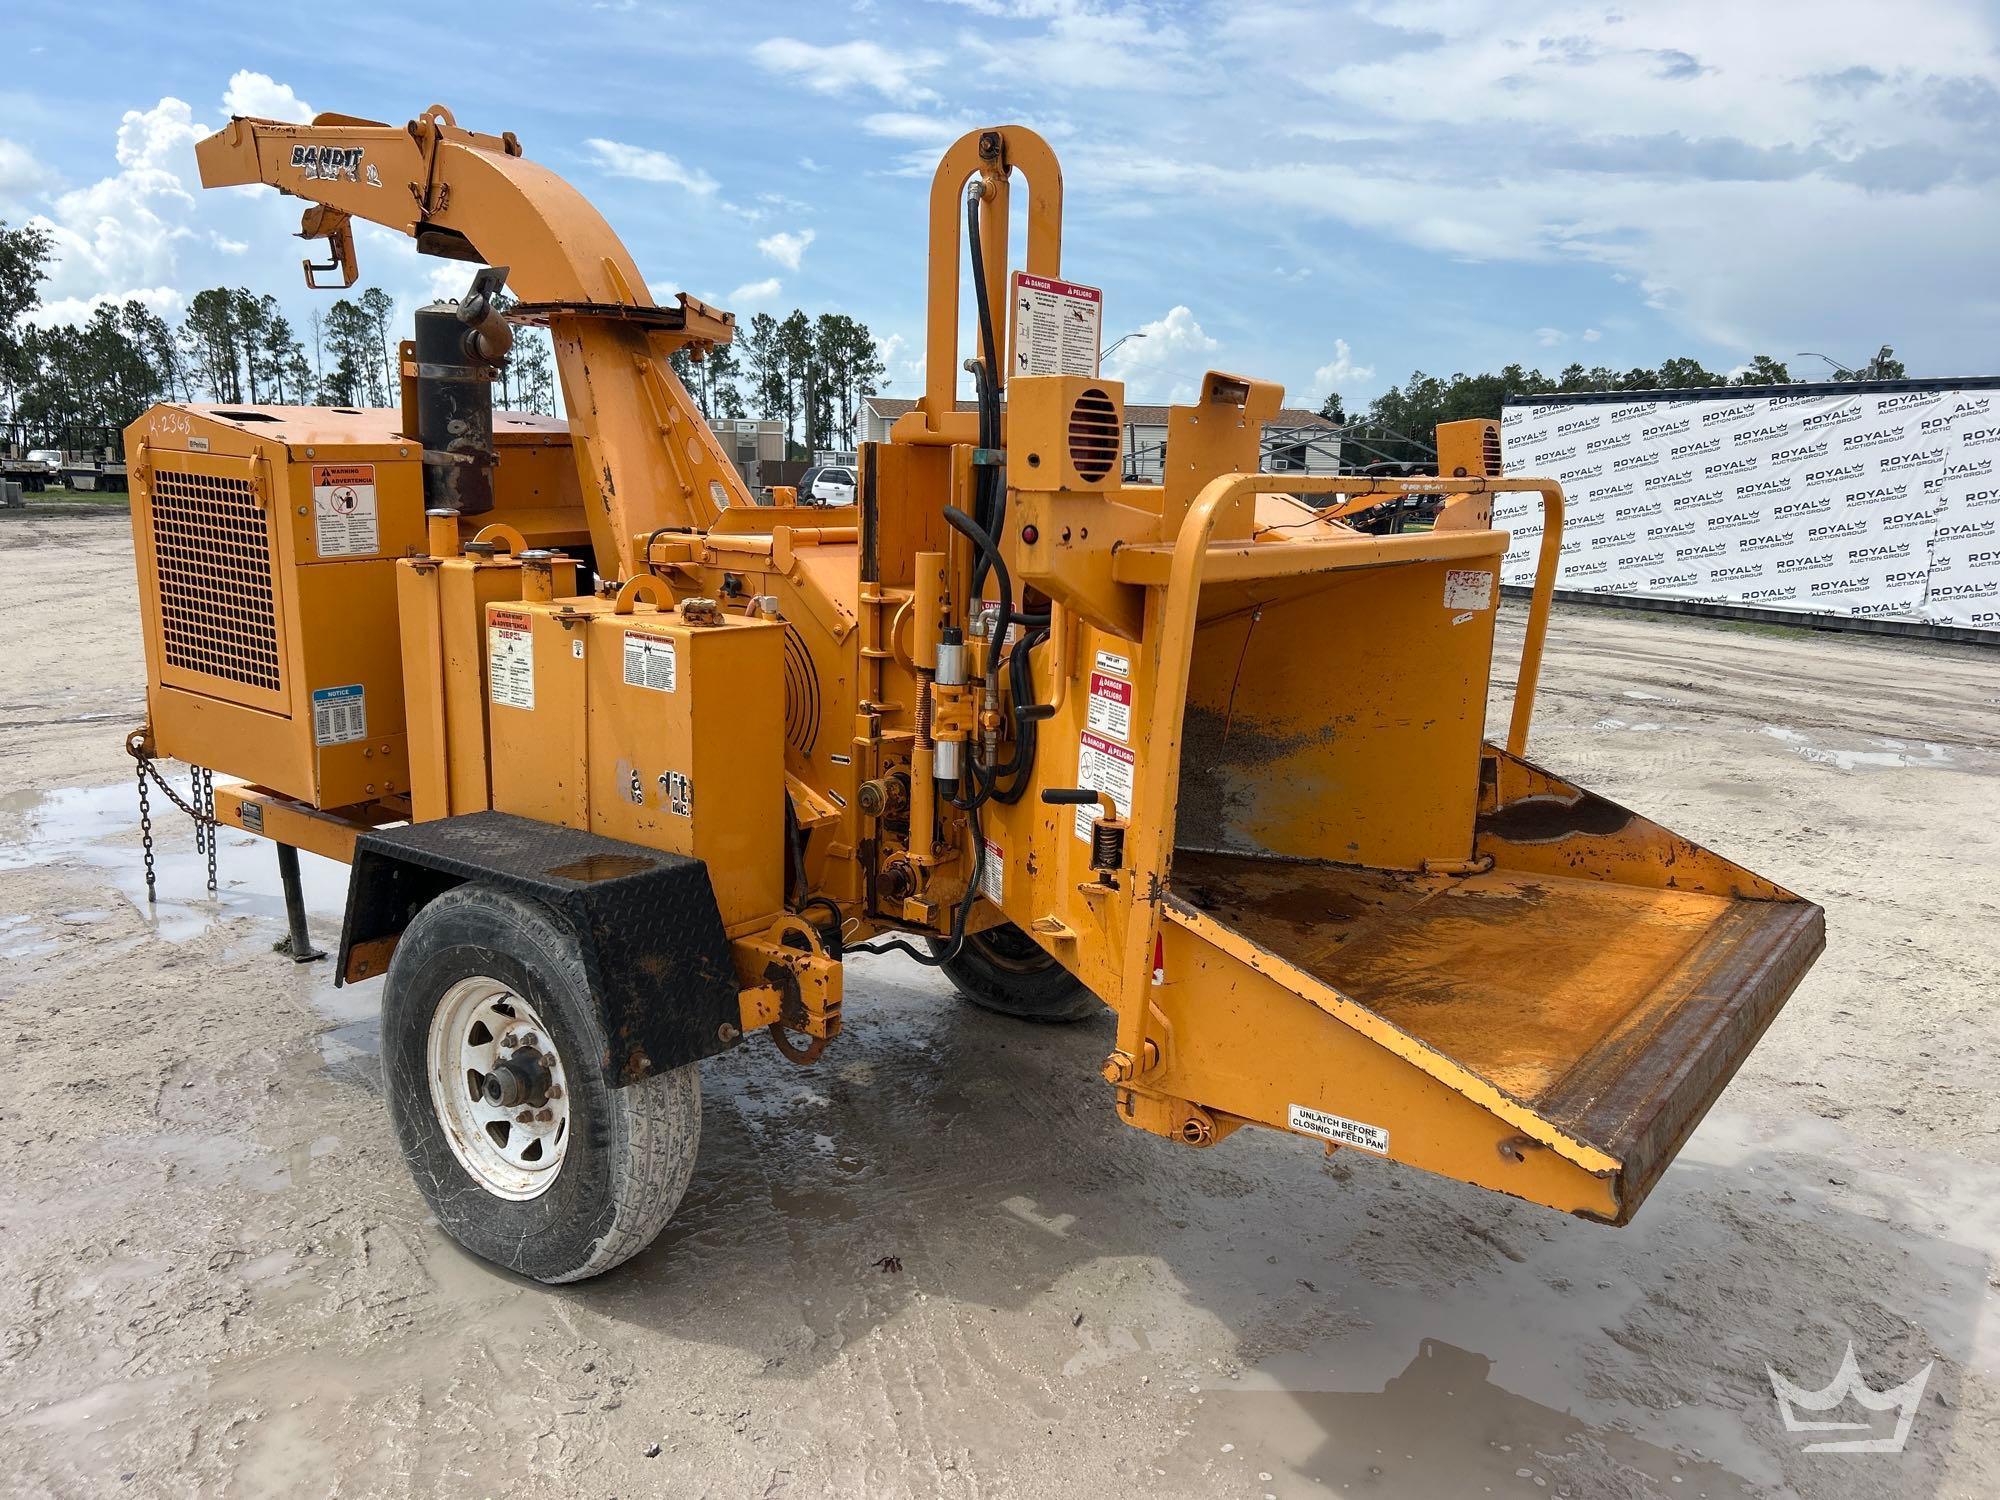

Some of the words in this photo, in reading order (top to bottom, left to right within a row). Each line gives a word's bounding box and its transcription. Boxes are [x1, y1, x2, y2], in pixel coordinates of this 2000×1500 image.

[290, 145, 364, 168] BANDIT
[1031, 280, 1051, 289] DANGER
[1073, 289, 1092, 298] PELIGRO
[1770, 402, 1800, 412] AUCTION
[1878, 392, 1928, 410] ROYAL
[1879, 404, 1912, 415] AUCTION
[1914, 397, 1942, 408] GROUP
[1611, 406, 1647, 419] ROYAL
[1702, 407, 1744, 422] ROYAL
[1803, 410, 1849, 426] ROYAL
[1961, 408, 1990, 418] GROUP
[1558, 419, 1591, 433] ROYAL
[1703, 417, 1731, 427] AUCTION
[1732, 412, 1755, 421] GROUP
[1804, 421, 1835, 431] AUCTION
[1836, 415, 1862, 424] GROUP
[1921, 416, 1952, 429] ROY
[1642, 422, 1680, 436] ROYAL
[1734, 426, 1776, 441] ROYAL
[1922, 426, 1951, 435] AUCTIO
[1508, 432, 1539, 445] ROYAL
[1587, 436, 1621, 450] ROYAL
[1643, 432, 1668, 441] AUCTION
[1735, 437, 1763, 446] AUCTION
[1764, 432, 1788, 440] GROUP
[1843, 430, 1891, 446] ROYAL
[1844, 441, 1876, 451] AUCTION
[1878, 435, 1904, 444] GROUP
[1588, 445, 1611, 454] AUCTION
[1671, 441, 1710, 455] ROYAL
[1771, 446, 1816, 460] ROYAL
[1535, 449, 1567, 462] ROYAL
[1614, 455, 1649, 468] ROYAL
[1672, 451, 1698, 460] AUCTION
[1772, 456, 1802, 466] AUCTION
[1803, 451, 1828, 459] GROUP
[1880, 451, 1930, 467] ROYAL
[1614, 464, 1638, 472] AUCTION
[1705, 460, 1746, 474] ROYAL
[1881, 462, 1915, 472] AUCTION
[1916, 457, 1944, 466] GROUP
[1560, 467, 1593, 480] ROYAL
[1706, 470, 1733, 479] AUCTION
[1734, 465, 1757, 474] GROUP
[1806, 466, 1852, 481] ROYAL
[1964, 469, 1992, 478] GROUP
[1645, 473, 1682, 486] ROYAL
[1806, 477, 1838, 486] AUCTION
[1839, 472, 1864, 481] GROUP
[1589, 485, 1624, 497] ROYAL
[1646, 483, 1671, 491] AUCTION
[1737, 480, 1779, 494] ROYAL
[1674, 493, 1712, 506] ROYAL
[1737, 490, 1766, 499] AUCTION
[1846, 488, 1894, 502] ROYAL
[1847, 498, 1879, 507] AUCTION
[1880, 494, 1907, 502] GROUP
[1966, 489, 2000, 502] ROY
[1616, 504, 1652, 517] ROYAL
[1674, 503, 1701, 511] AUCTION
[1774, 501, 1818, 514] ROYAL
[1564, 515, 1596, 526] ROYAL
[1708, 513, 1749, 526] ROYAL
[1775, 511, 1805, 520] AUCTION
[1883, 510, 1933, 525] ROYAL
[1513, 525, 1543, 536] ROYAL
[1647, 524, 1685, 536] ROYAL
[1808, 523, 1854, 536] ROYAL
[1884, 521, 1918, 530] AUCTION
[1919, 519, 1937, 527] GRO
[1592, 534, 1626, 545] ROYAL
[1740, 534, 1782, 547] ROYAL
[1809, 533, 1840, 541] AUCTION
[1966, 530, 1995, 538] GROUP
[1676, 545, 1715, 557] ROYAL
[1849, 545, 1897, 558] ROYAL
[1968, 552, 2000, 562] ROY
[1618, 554, 1654, 565] ROYAL
[1777, 556, 1821, 568] ROYAL
[1849, 556, 1882, 564] AUCTION
[1565, 563, 1598, 573] ROYAL
[1711, 566, 1751, 577] ROYAL
[1650, 575, 1688, 585] ROYAL
[1886, 570, 1926, 582] ROYA
[1594, 582, 1629, 592] ROYAL
[1811, 579, 1857, 591] ROYAL
[1887, 580, 1920, 588] AUCTION
[1931, 584, 1983, 596] ROYAL
[1742, 588, 1784, 600] ROYAL
[1851, 604, 1899, 613] ROYAL
[501, 612, 522, 620] WARNING
[497, 621, 528, 630] ADVERTENCIA
[1104, 678, 1122, 690] DANGER
[1103, 689, 1122, 701] PELIGRO
[1087, 737, 1105, 750] DANGER
[1113, 748, 1134, 762] PELIGRO
[1300, 1110, 1339, 1127] UNLATCH
[1341, 1122, 1377, 1138] BEFORE
[1292, 1118, 1330, 1134] CLOSING
[1332, 1128, 1364, 1144] INFEED
[1366, 1138, 1384, 1149] PAN
